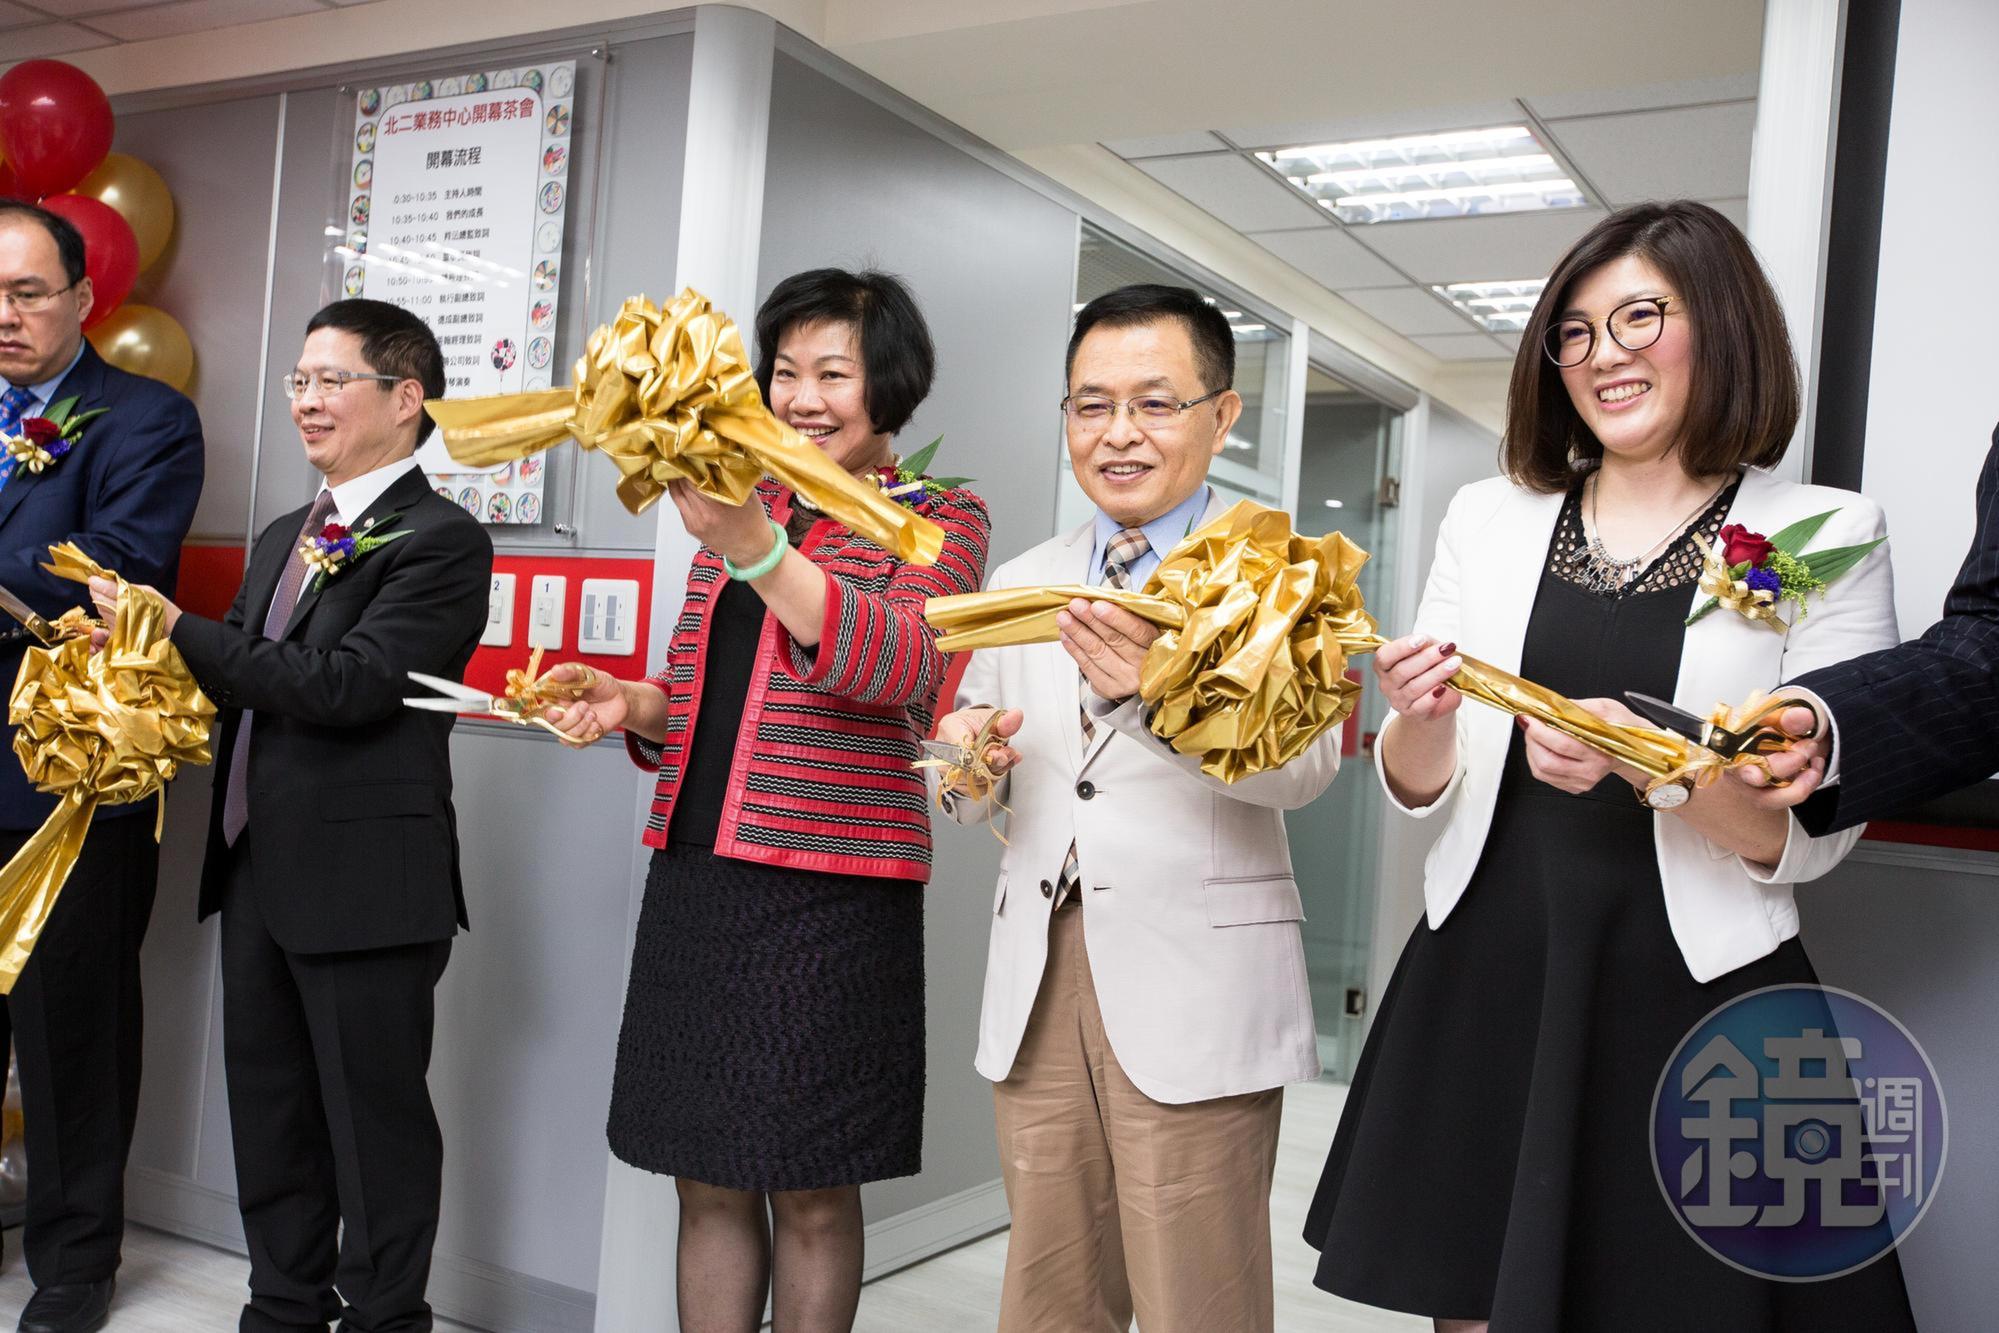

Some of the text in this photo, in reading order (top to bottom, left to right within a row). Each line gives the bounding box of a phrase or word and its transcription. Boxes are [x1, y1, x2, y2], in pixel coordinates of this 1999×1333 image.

[384, 97, 535, 136] 北二業務中心開幕茶會
[426, 146, 482, 170] 開幕流程
[494, 580, 500, 591] 2
[545, 582, 549, 592] 1
